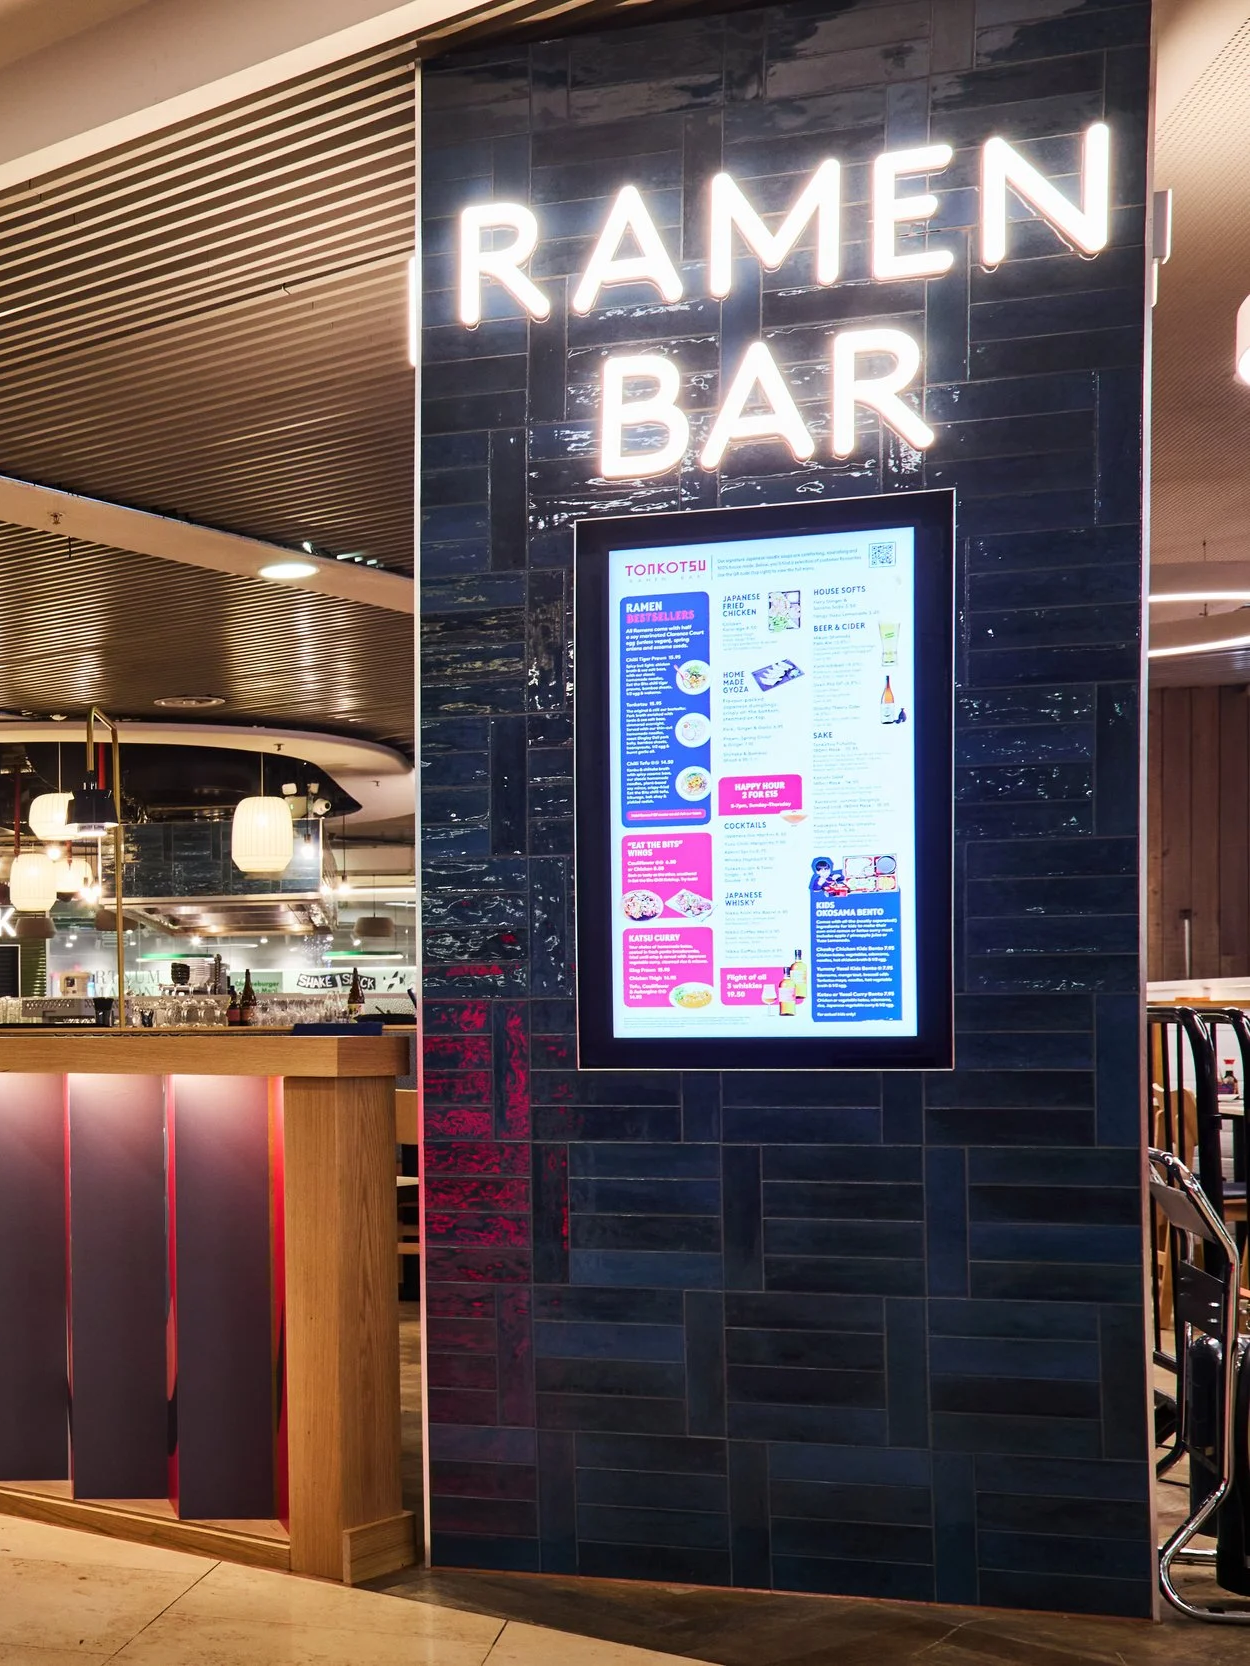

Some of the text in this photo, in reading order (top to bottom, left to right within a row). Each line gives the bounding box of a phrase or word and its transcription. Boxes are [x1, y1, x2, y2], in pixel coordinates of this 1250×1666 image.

[458, 122, 1111, 328] RAMEN
[599, 328, 936, 480] BAR
[813, 585, 866, 596] HOUSE SOFTS
[723, 593, 761, 602] JAPANESE
[626, 601, 663, 613] RAMEN
[723, 602, 745, 610] FRIED
[626, 610, 695, 624] BESTSELLERS
[723, 608, 757, 617] CHICKEN
[813, 624, 834, 632] BEER
[841, 622, 866, 631] CIDER
[723, 670, 745, 678] HOME
[723, 678, 745, 686] MADE
[813, 731, 833, 739] SAKE
[734, 781, 786, 791] HAPPY HOUR
[741, 789, 779, 799] 2 FOR £15
[724, 821, 767, 830] COCKTAILS
[646, 841, 661, 849] THE
[628, 848, 654, 857] WINGS
[725, 891, 763, 899] JAPANESE
[816, 901, 835, 909] KIDS
[816, 907, 885, 917] OKOSAMA BENTO
[629, 933, 681, 942] KATSU CURRY
[297, 974, 334, 989] SHAKE
[726, 973, 767, 982] Flight of all
[726, 990, 746, 998] 19.50
